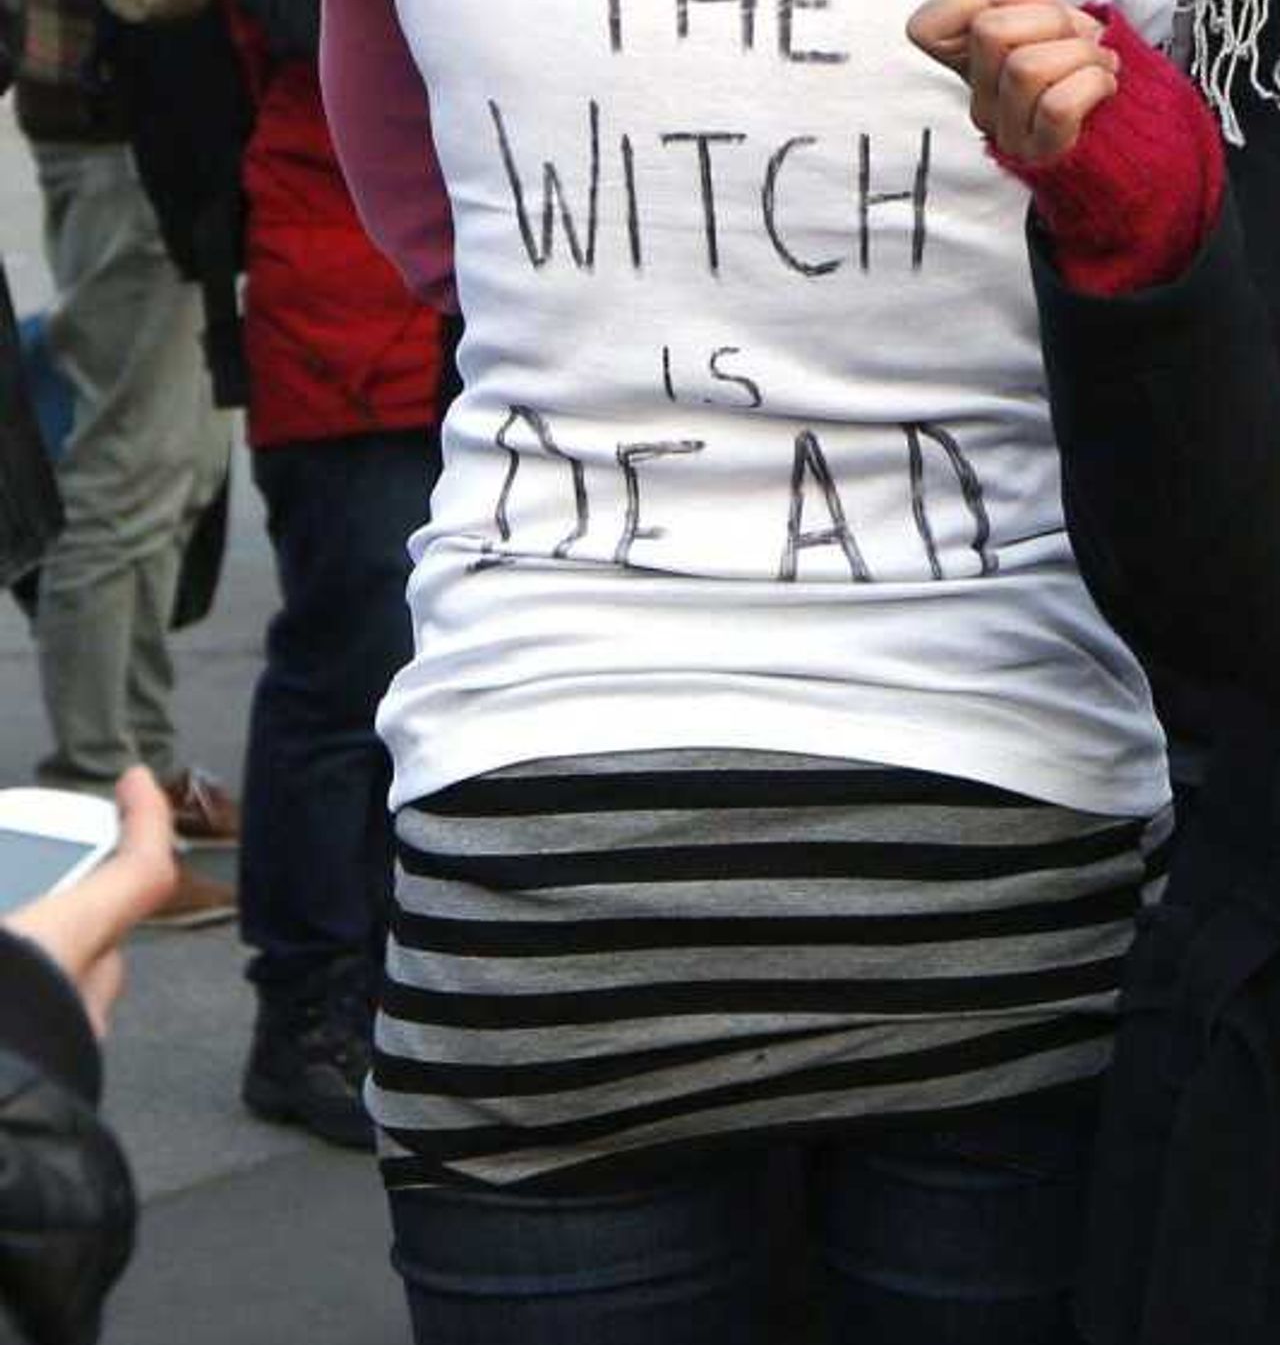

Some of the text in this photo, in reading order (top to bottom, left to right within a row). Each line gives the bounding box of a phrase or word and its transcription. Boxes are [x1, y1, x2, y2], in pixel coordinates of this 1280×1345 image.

[487, 97, 932, 278] WITCH
[662, 345, 764, 409] IS
[466, 404, 999, 583] DEAD
